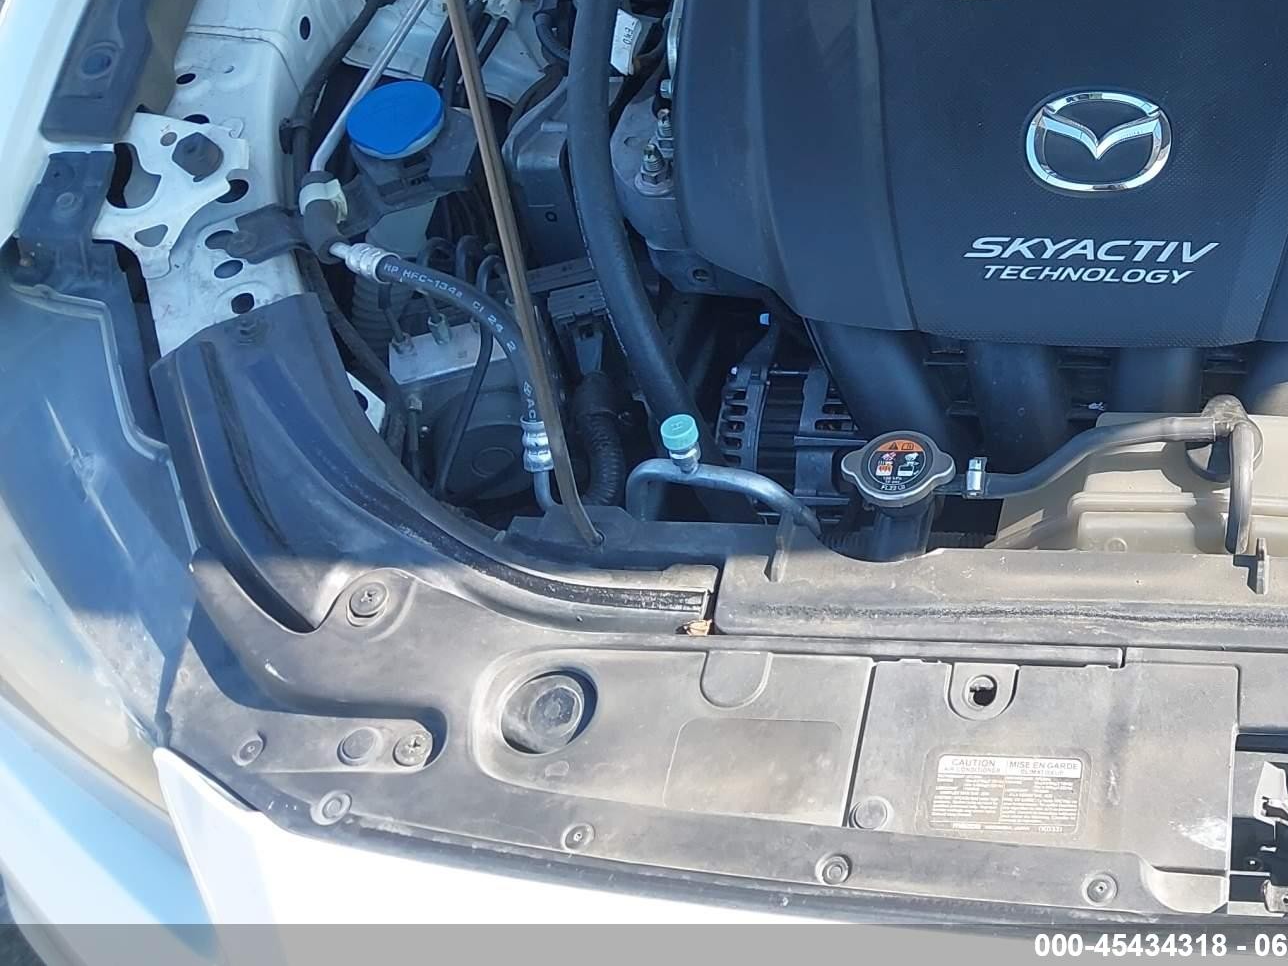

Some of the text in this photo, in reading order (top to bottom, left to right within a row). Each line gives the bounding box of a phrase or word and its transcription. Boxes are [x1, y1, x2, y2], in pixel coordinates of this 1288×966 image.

[963, 236, 1220, 263] SKYACTIV
[383, 262, 399, 274] HP
[982, 264, 1195, 284] TECHNOLOGY
[951, 758, 996, 767] CAUTION
[1009, 760, 1079, 770] MISE EN GARDE
